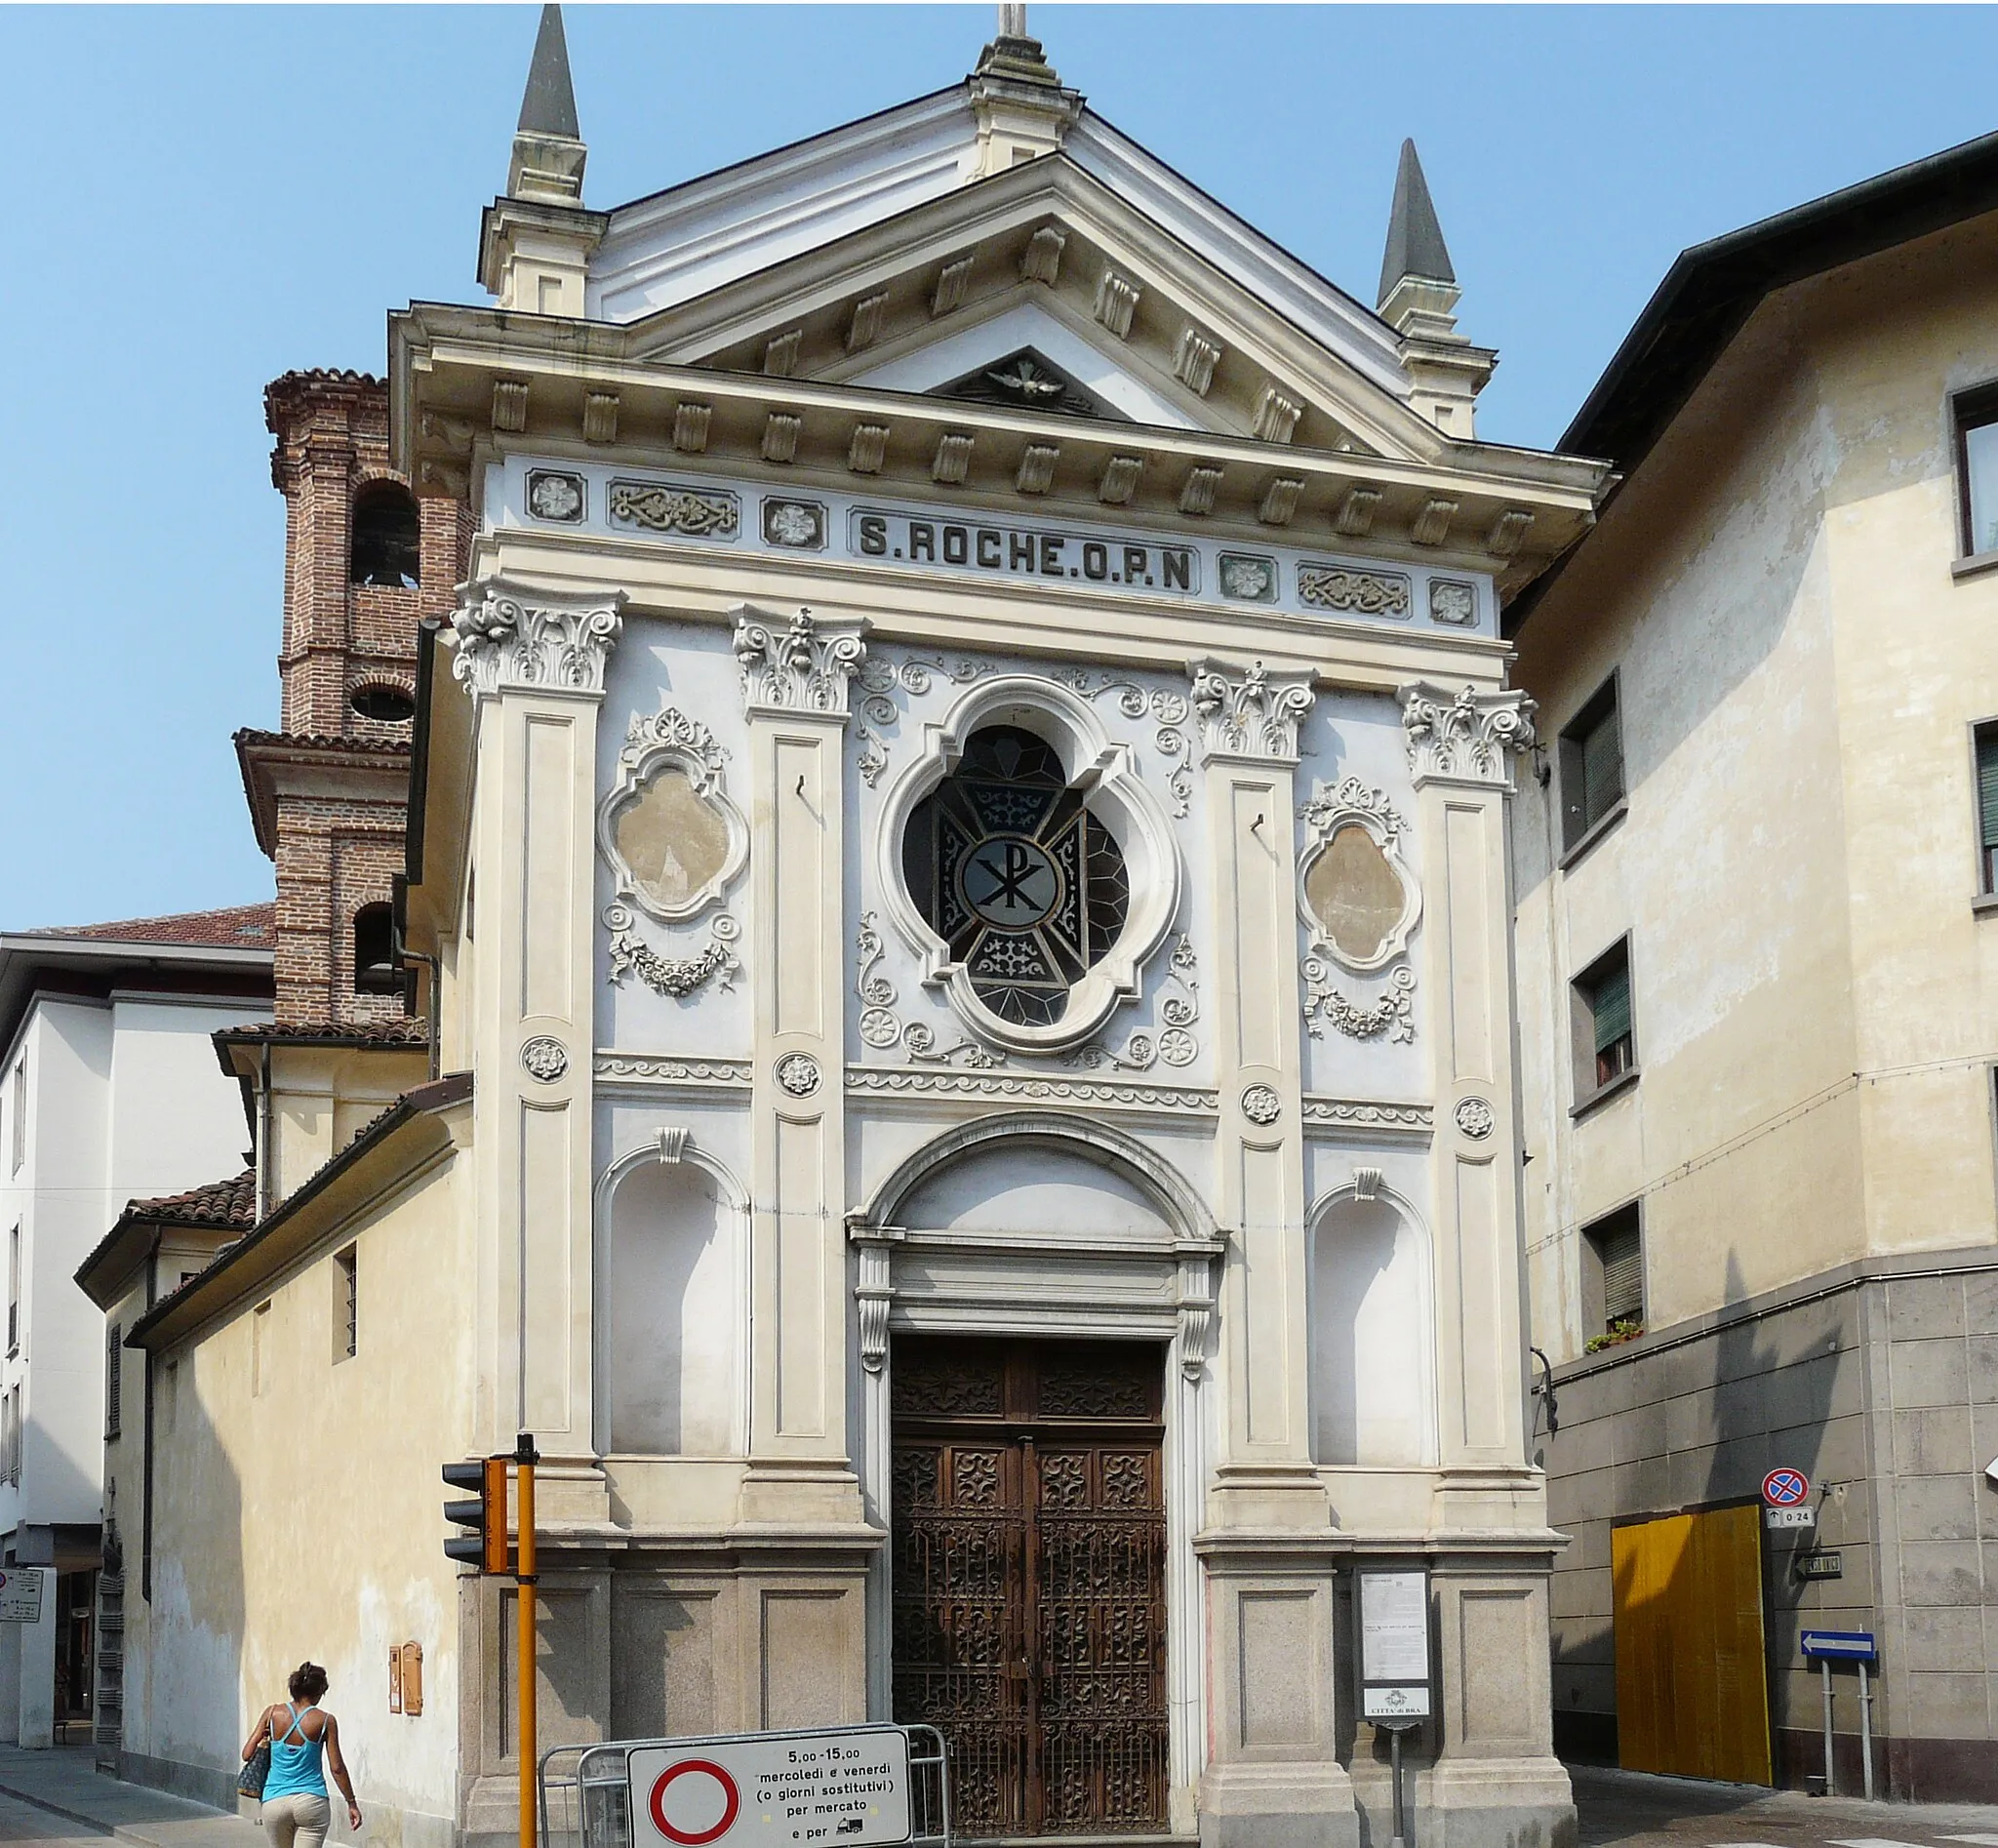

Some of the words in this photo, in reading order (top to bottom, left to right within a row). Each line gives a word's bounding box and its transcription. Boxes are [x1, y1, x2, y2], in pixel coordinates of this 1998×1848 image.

[756, 1789, 772, 1804] (o
[779, 1786, 815, 1801] giorni
[821, 1780, 895, 1796] sostitutivi)
[786, 1806, 808, 1818] per
[815, 1799, 867, 1814] mercato
[792, 1829, 800, 1839] e
[807, 1828, 828, 1840] per
